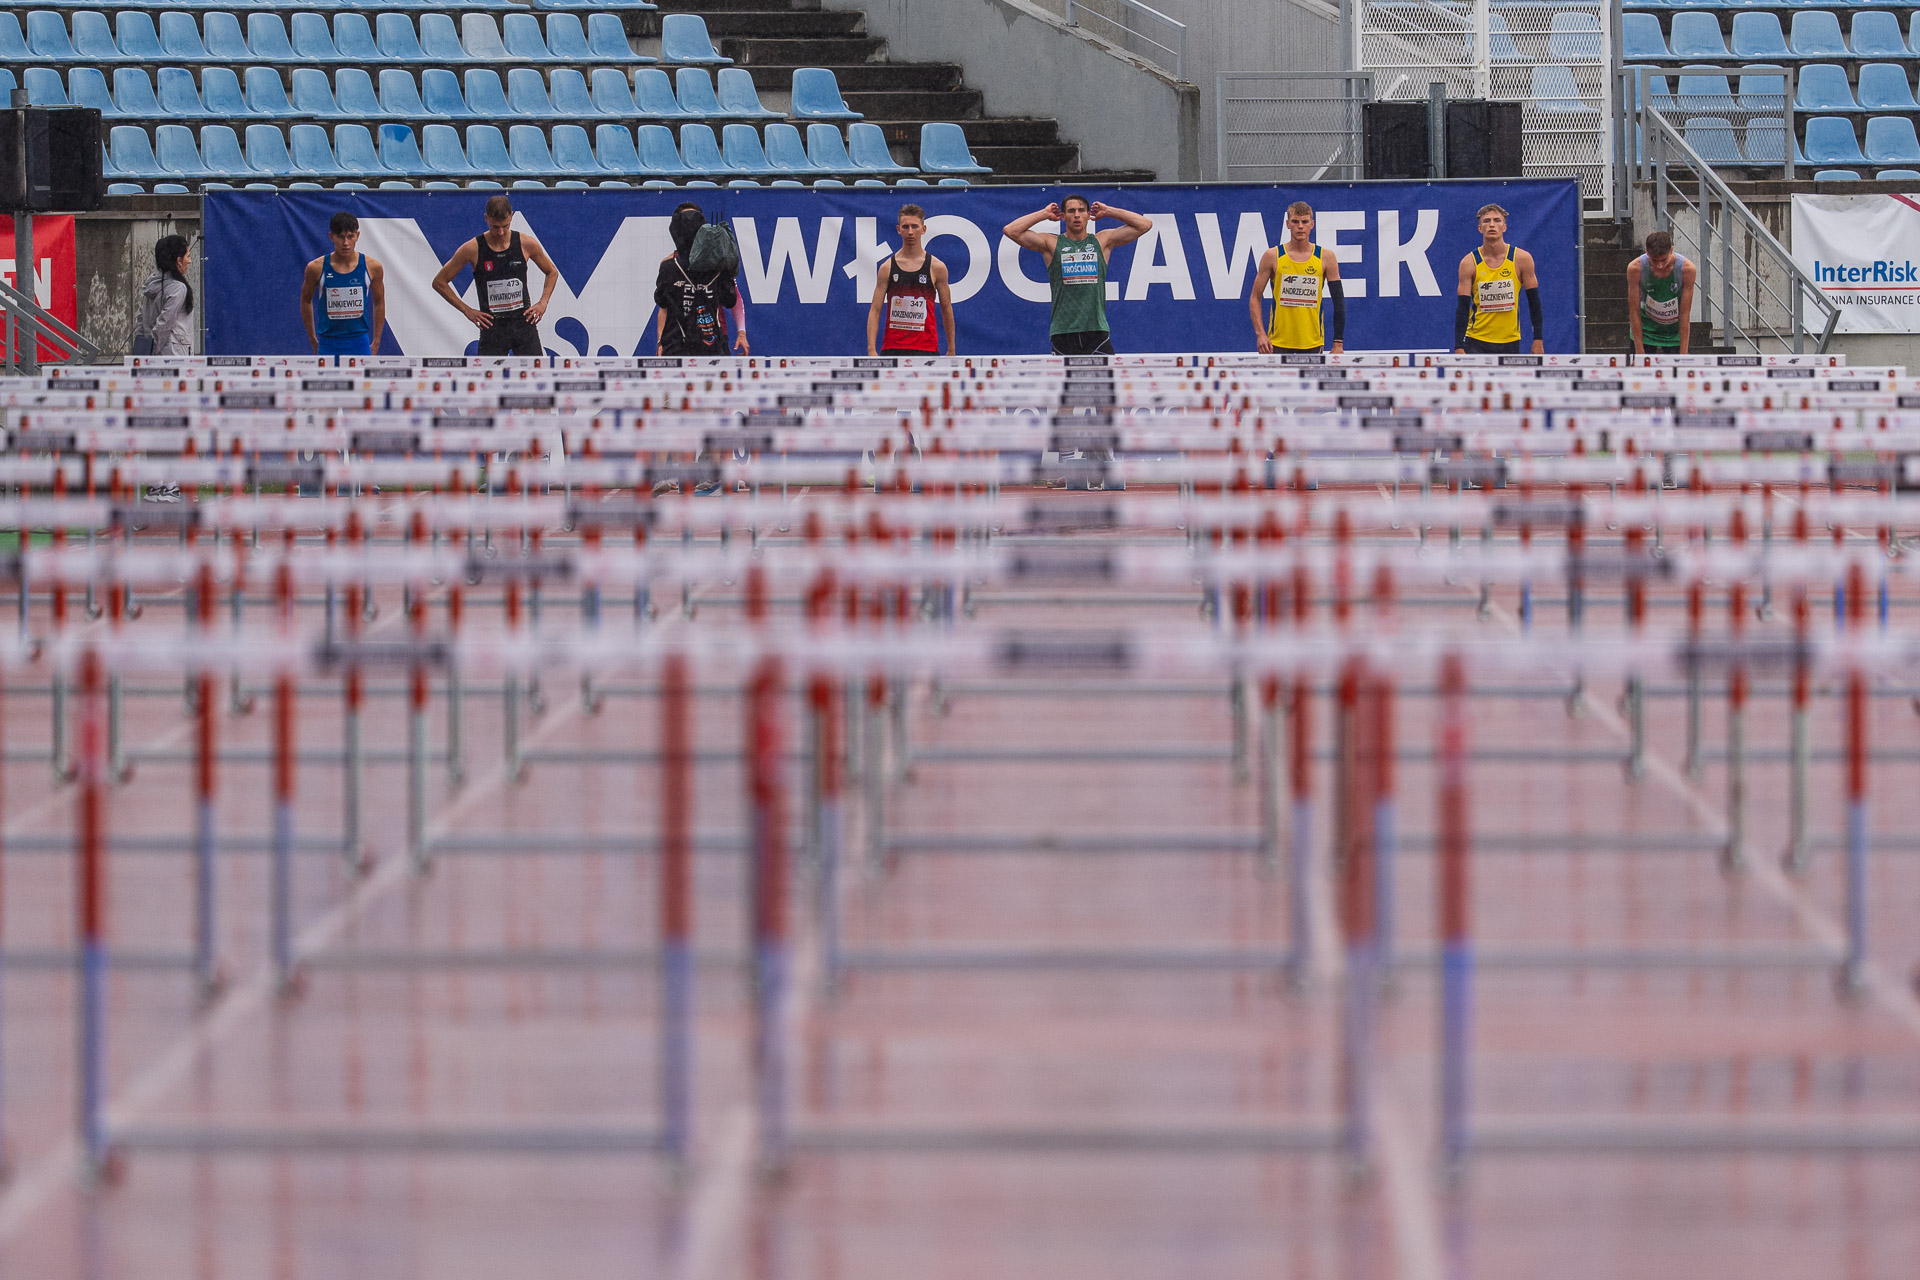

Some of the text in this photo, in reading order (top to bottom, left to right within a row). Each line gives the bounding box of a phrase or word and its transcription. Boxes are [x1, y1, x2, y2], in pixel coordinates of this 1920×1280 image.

[731, 209, 1443, 304] WŁOCAWEK
[1063, 264, 1097, 273] TROŚCIANKA
[1814, 261, 1918, 282] InterRisk
[1480, 282, 1493, 290] 4F
[490, 291, 521, 302] KWIATKOWSKI
[1282, 288, 1316, 297] ANDRZEJCZAK
[1480, 292, 1514, 302] ŻACZKIEWICZ
[328, 300, 362, 308] LINKIEWICZ
[1663, 300, 1675, 308] 369
[1815, 295, 1853, 305] VNNA
[1856, 295, 1914, 305] INSURANCE
[891, 310, 925, 320] KORZENIOWSKI
